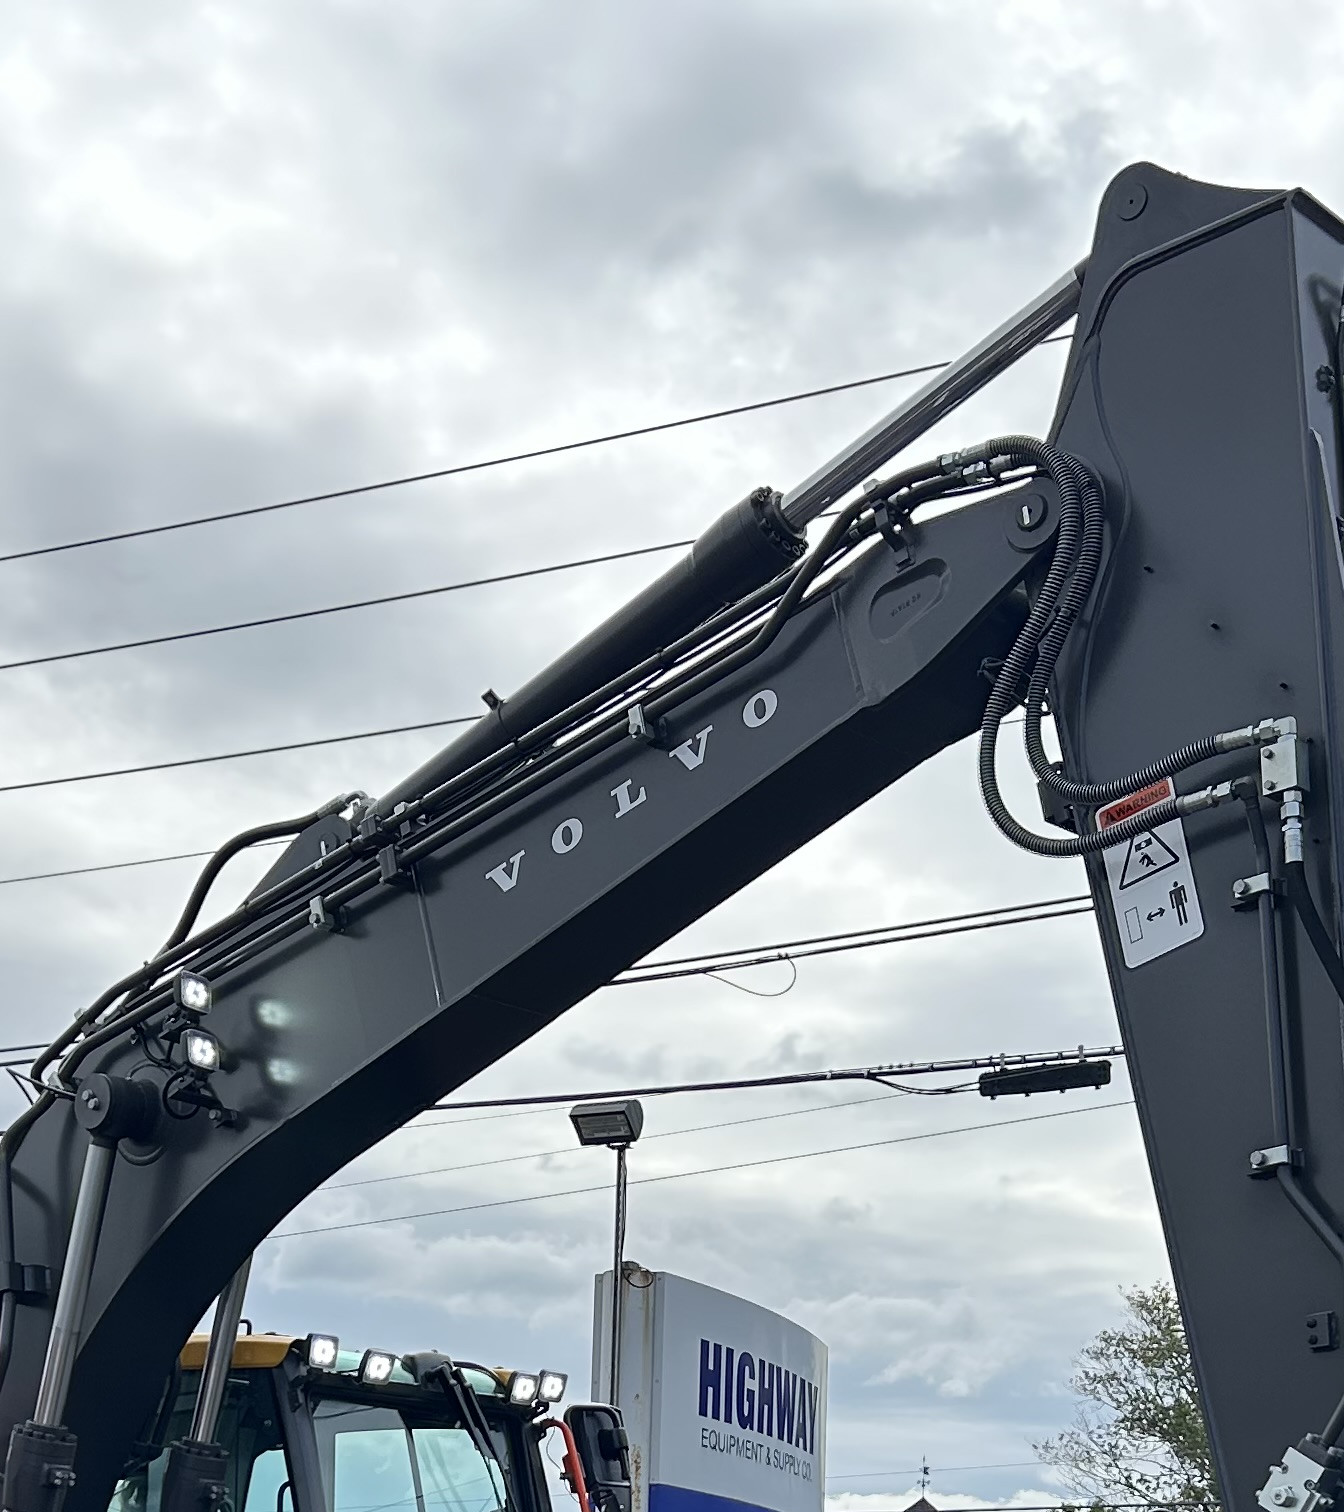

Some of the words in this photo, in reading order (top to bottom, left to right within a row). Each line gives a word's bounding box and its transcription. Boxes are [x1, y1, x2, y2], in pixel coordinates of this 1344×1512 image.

[485, 689, 778, 892] VOLVO
[1116, 786, 1167, 817] WARNING
[698, 1338, 819, 1456] HIGHWAY
[701, 1427, 764, 1464] EQUIPMENT
[765, 1446, 772, 1467] &
[773, 1449, 801, 1476] SUPPLY
